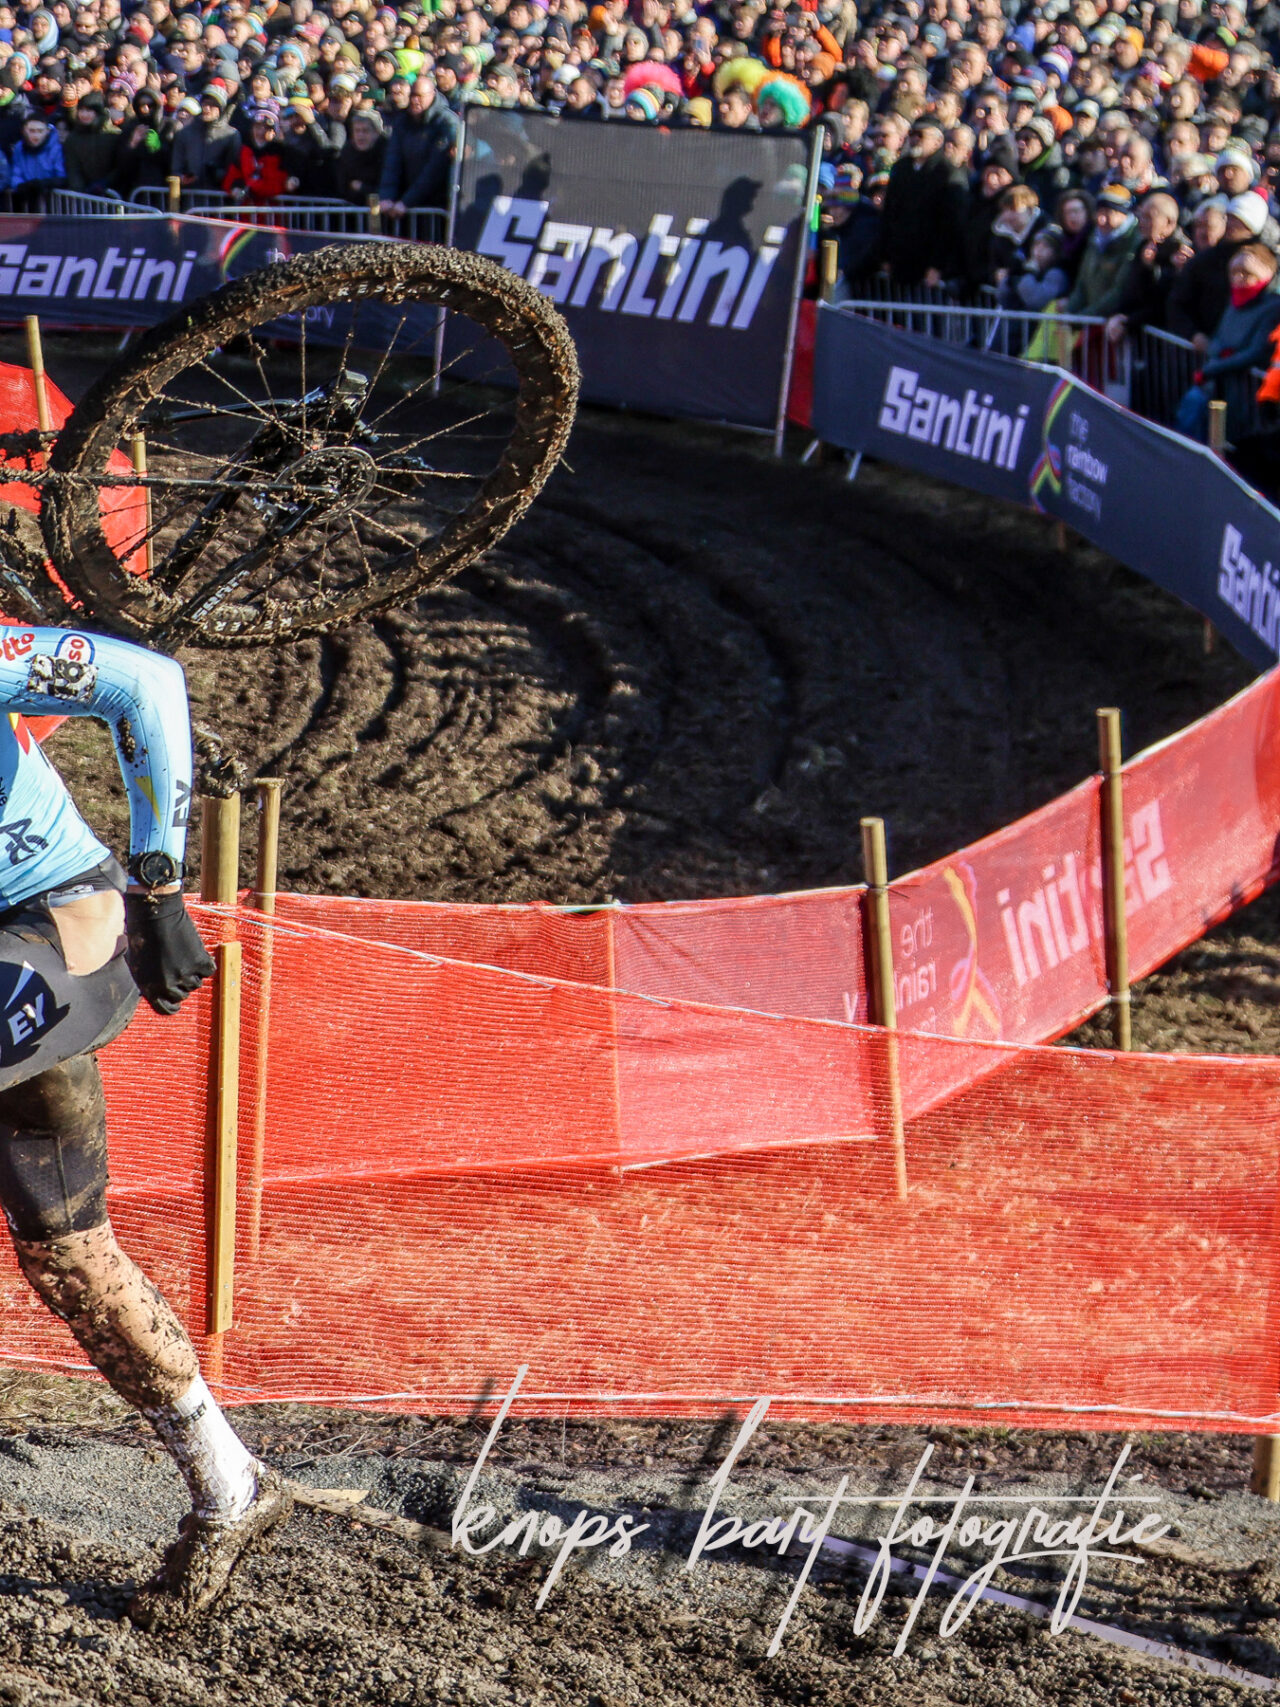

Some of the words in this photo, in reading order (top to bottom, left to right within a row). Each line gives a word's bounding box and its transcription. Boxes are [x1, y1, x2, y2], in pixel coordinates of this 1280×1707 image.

[475, 195, 787, 330] Santini
[878, 366, 1029, 471] Santini
[1066, 444, 1108, 484] rainbow
[7, 992, 45, 1046] EY
